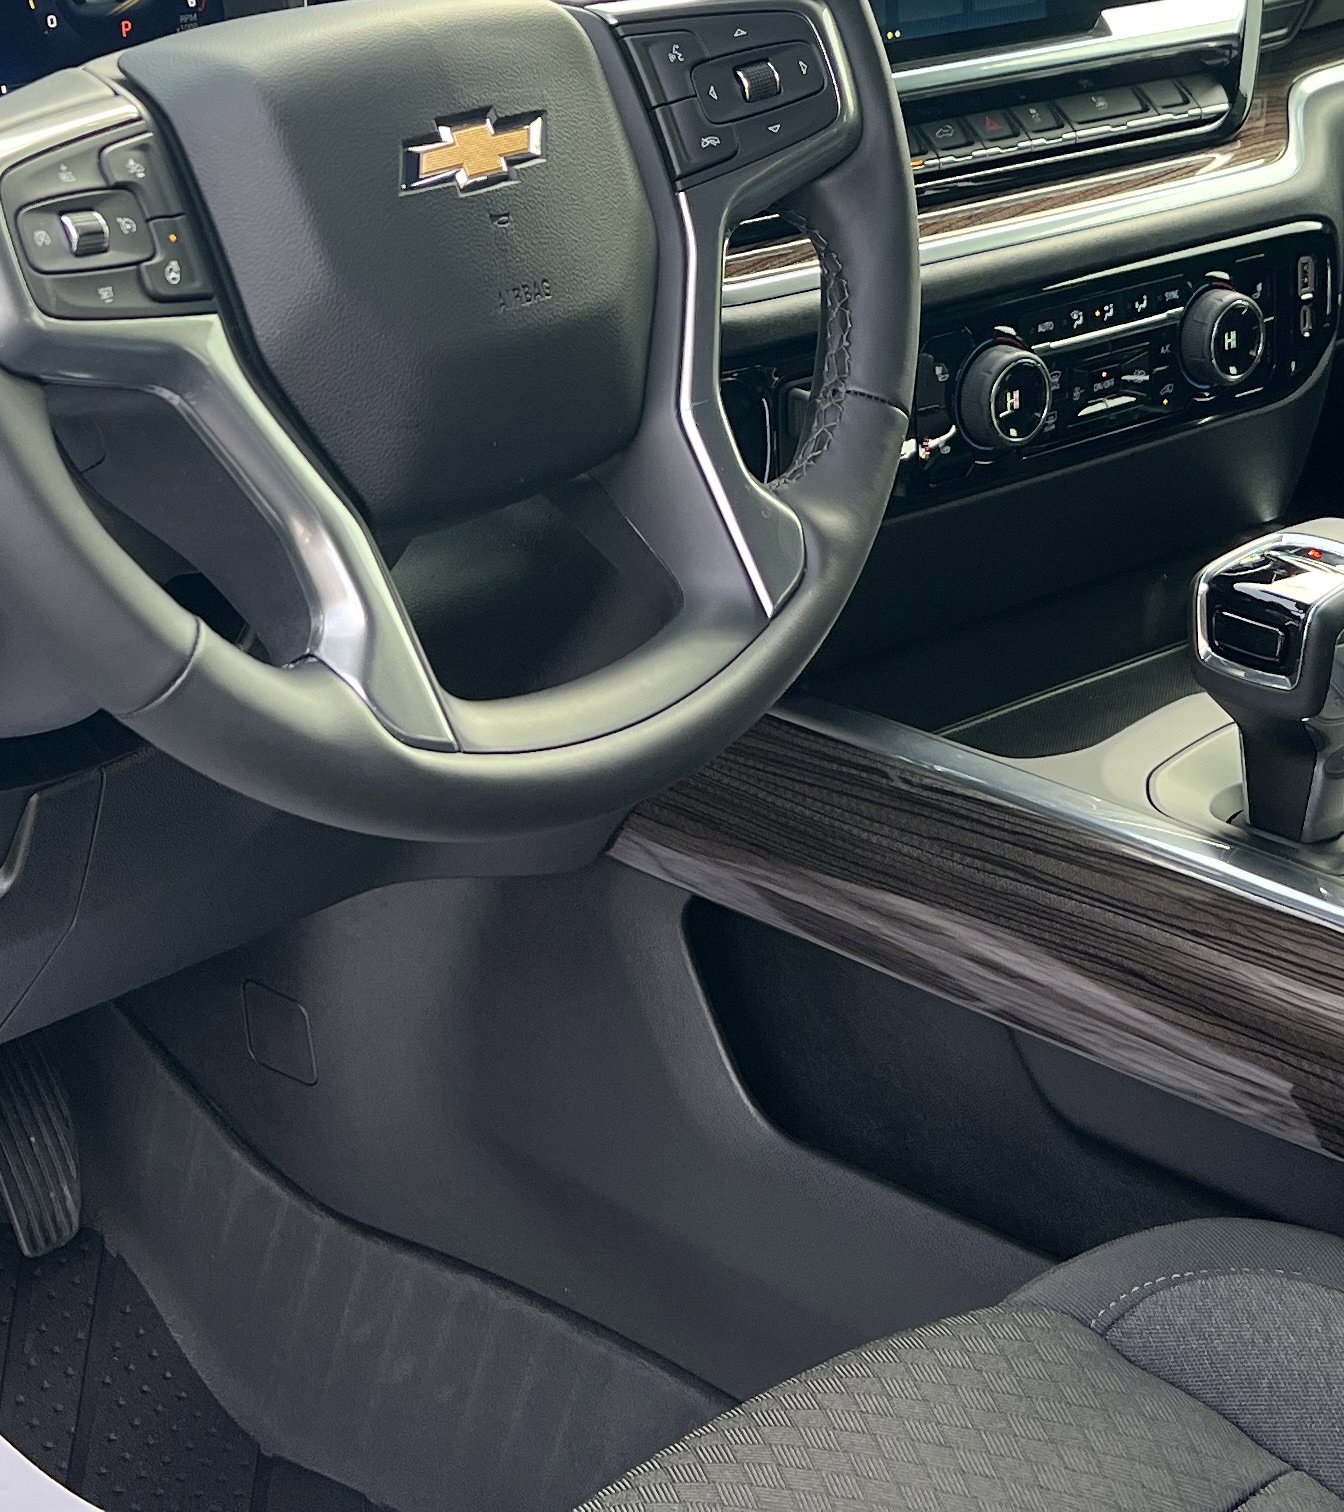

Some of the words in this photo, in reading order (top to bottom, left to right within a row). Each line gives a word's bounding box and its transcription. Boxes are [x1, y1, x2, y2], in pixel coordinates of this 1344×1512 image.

[46, 14, 57, 28] 0
[121, 20, 132, 38] P
[498, 278, 553, 309] AIRBAG
